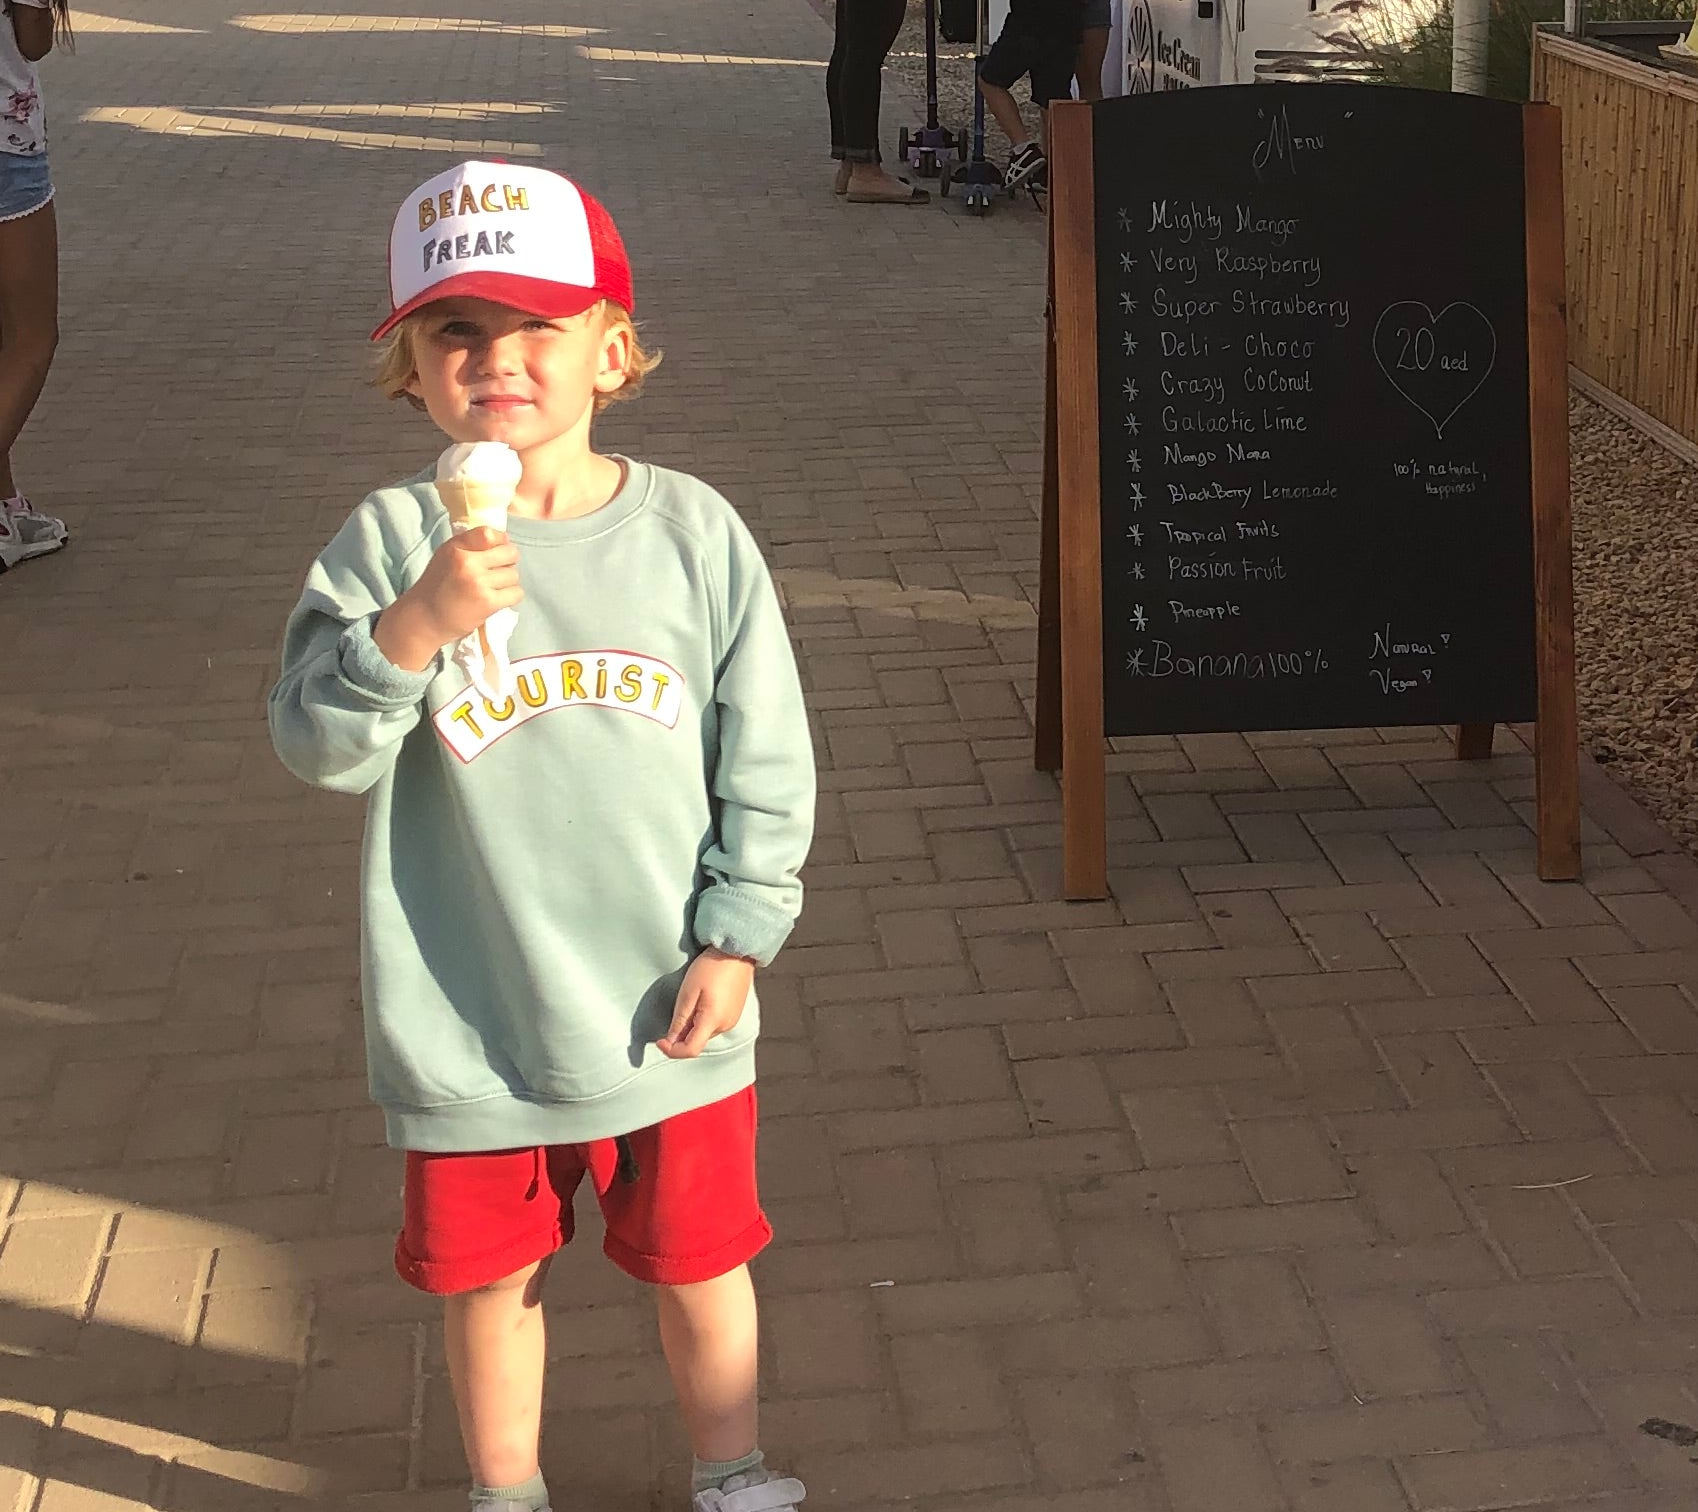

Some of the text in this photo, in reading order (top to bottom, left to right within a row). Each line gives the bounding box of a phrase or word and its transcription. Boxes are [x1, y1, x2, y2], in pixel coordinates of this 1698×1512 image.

[418, 183, 530, 232] BEACH
[1147, 200, 1300, 246] Mighty Mango
[423, 230, 516, 273] FREAK
[1150, 247, 1321, 287] Very Raspberry
[1151, 287, 1350, 327] Super Strawberry
[1160, 331, 1209, 357] Deli
[1245, 333, 1315, 358] Choco
[1396, 327, 1469, 371] 20 aed
[1161, 370, 1225, 404] Crazy
[1162, 405, 1307, 432] Galactic Lime
[1163, 442, 1217, 467] Mango
[1263, 479, 1337, 500] Lemonade
[1159, 519, 1280, 543] Tropical Fruits
[1168, 551, 1287, 581] Passion Fruit
[1168, 600, 1241, 623] Pineapple
